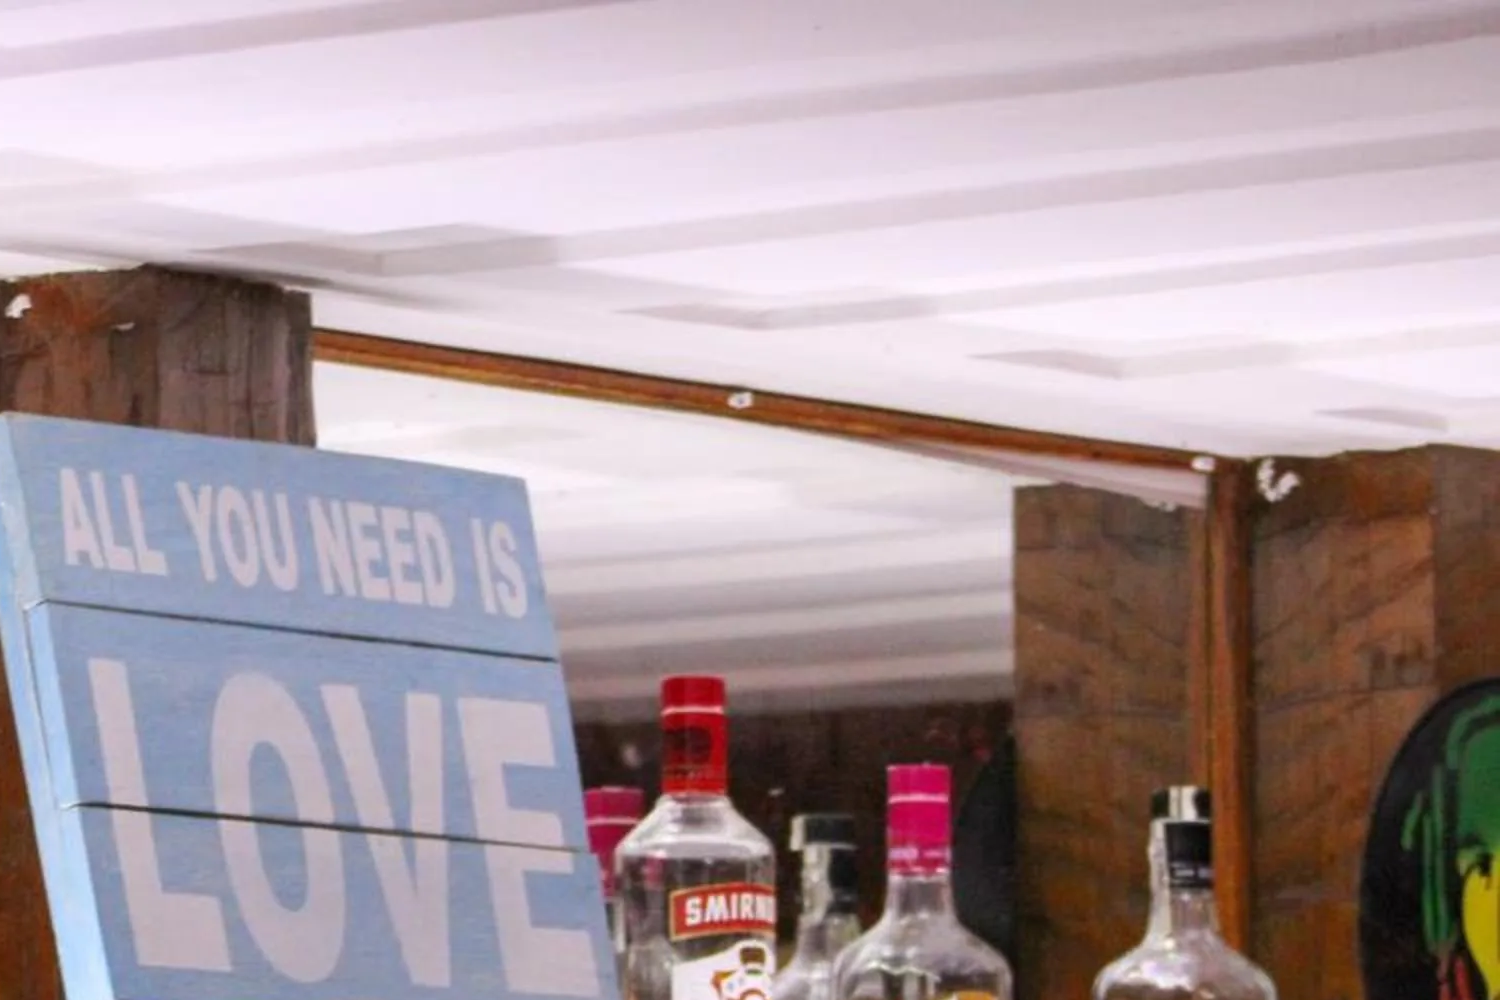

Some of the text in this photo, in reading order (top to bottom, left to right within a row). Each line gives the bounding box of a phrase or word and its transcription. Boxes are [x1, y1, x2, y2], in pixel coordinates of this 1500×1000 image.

[58, 467, 528, 619] ALL YOU NEED IS
[87, 657, 600, 998] LOVE
